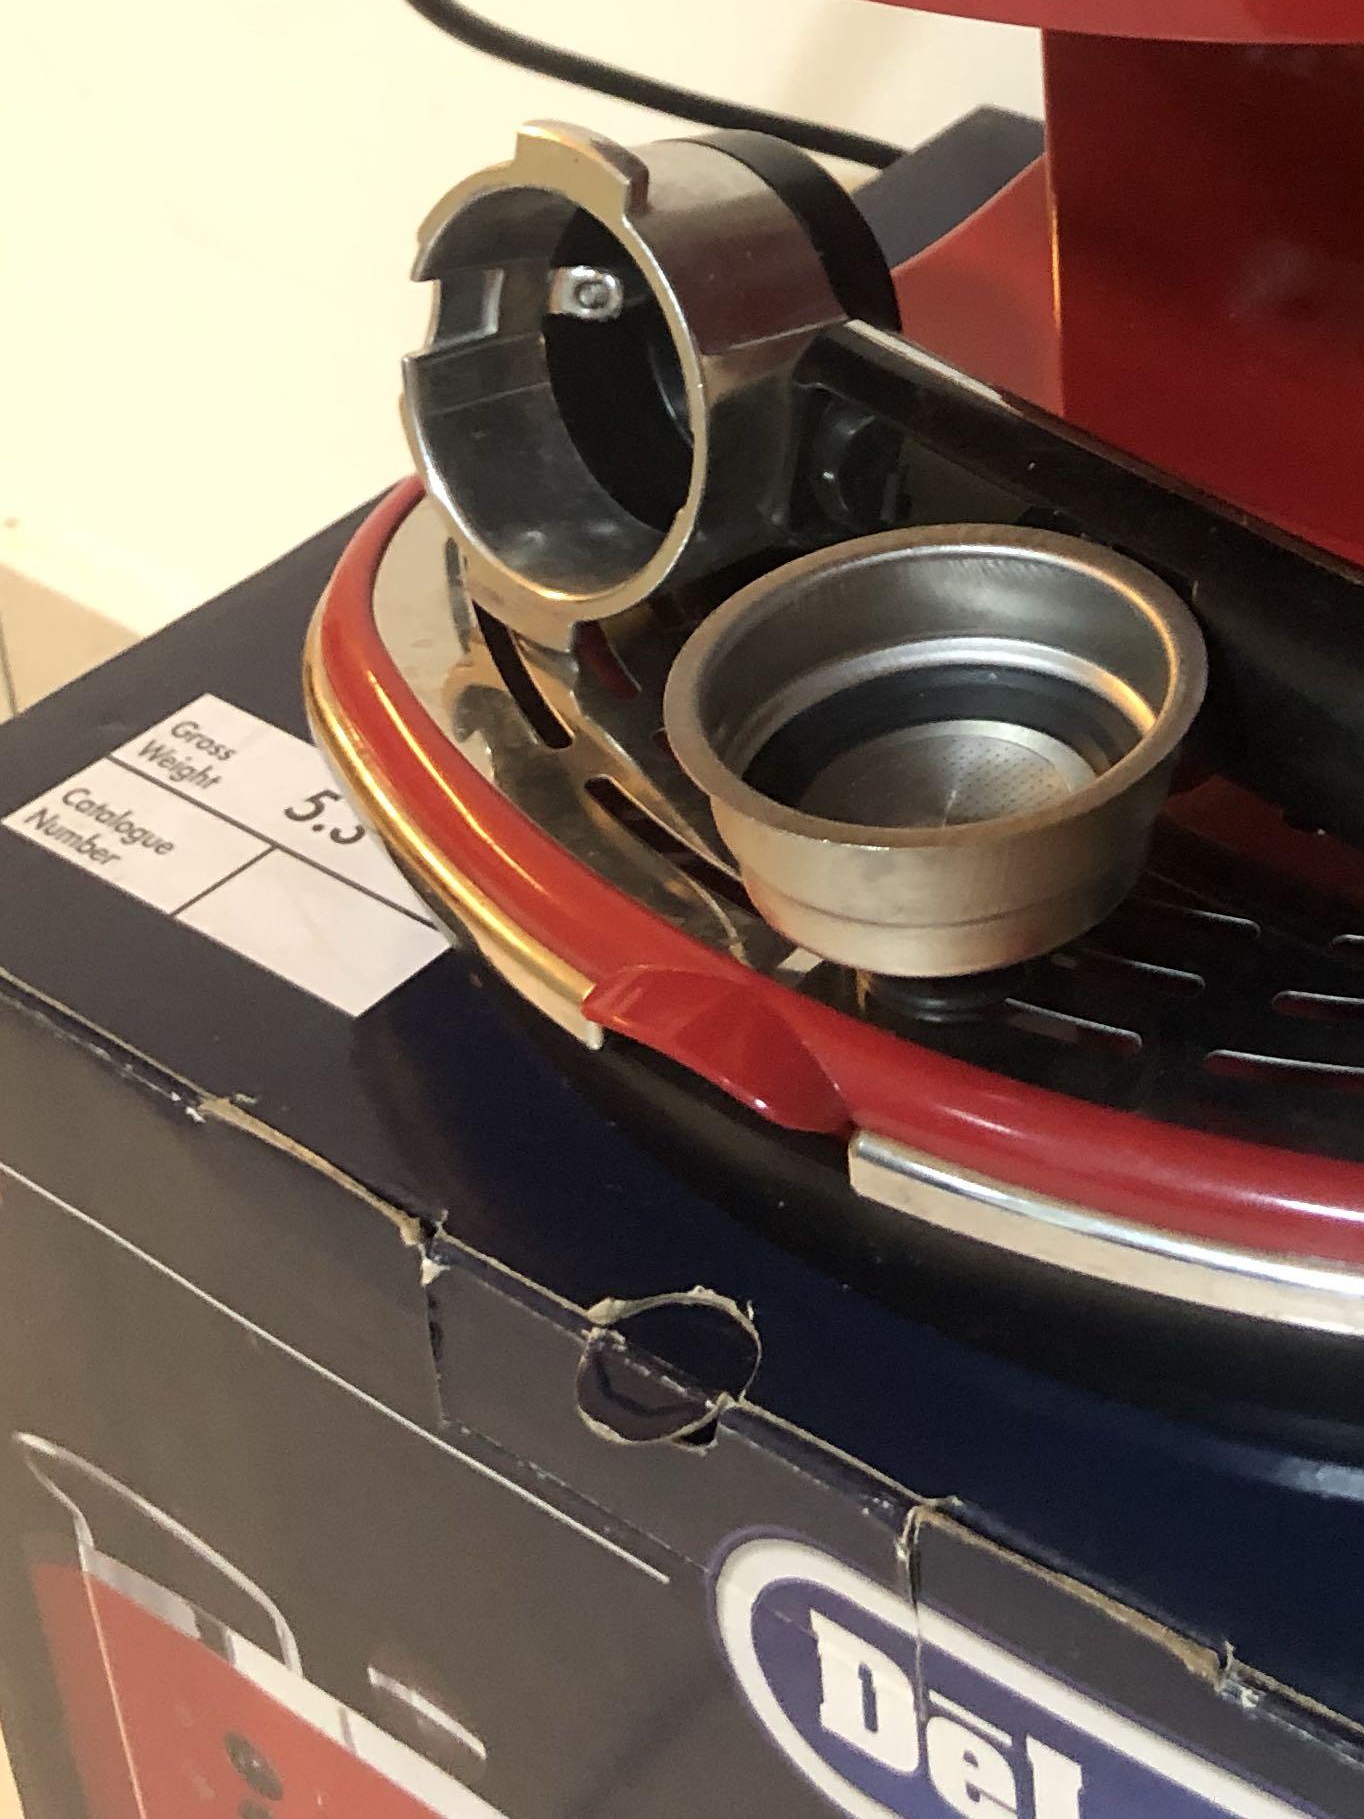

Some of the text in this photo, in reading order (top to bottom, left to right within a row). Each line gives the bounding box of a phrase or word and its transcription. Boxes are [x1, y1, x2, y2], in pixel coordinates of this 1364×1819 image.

[138, 739, 223, 789] Weight
[170, 720, 237, 762] Gross
[24, 806, 122, 866] Number
[62, 787, 175, 856] Catalogue
